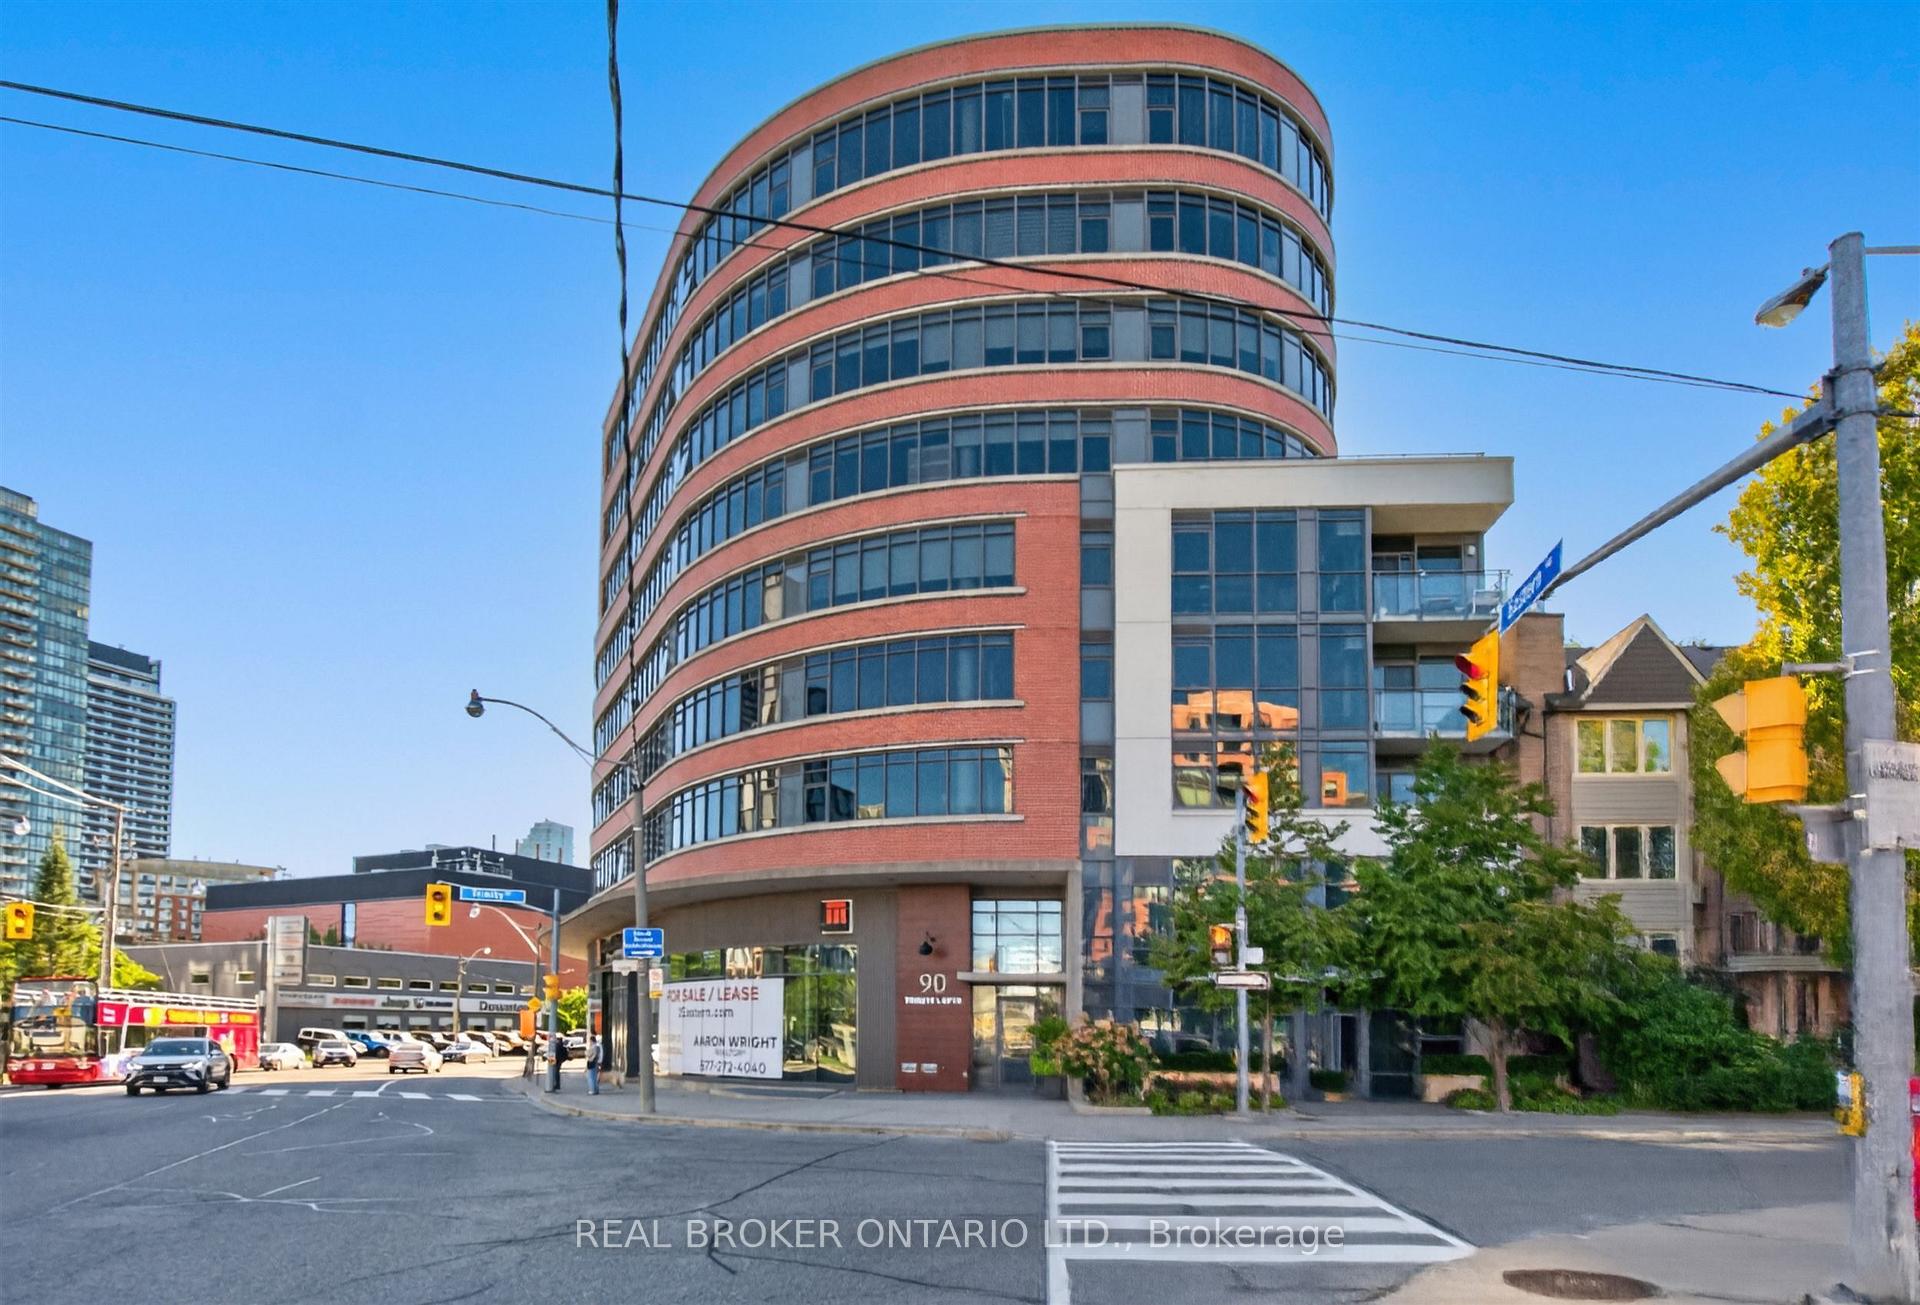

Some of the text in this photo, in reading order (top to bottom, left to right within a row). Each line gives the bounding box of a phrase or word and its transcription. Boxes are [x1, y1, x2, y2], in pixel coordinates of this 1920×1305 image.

[919, 973, 946, 993] 90
[682, 988, 705, 1002] SALE
[717, 986, 759, 1001] LEASE
[693, 1035, 725, 1047] AARON
[728, 1036, 777, 1049] WRIGHT
